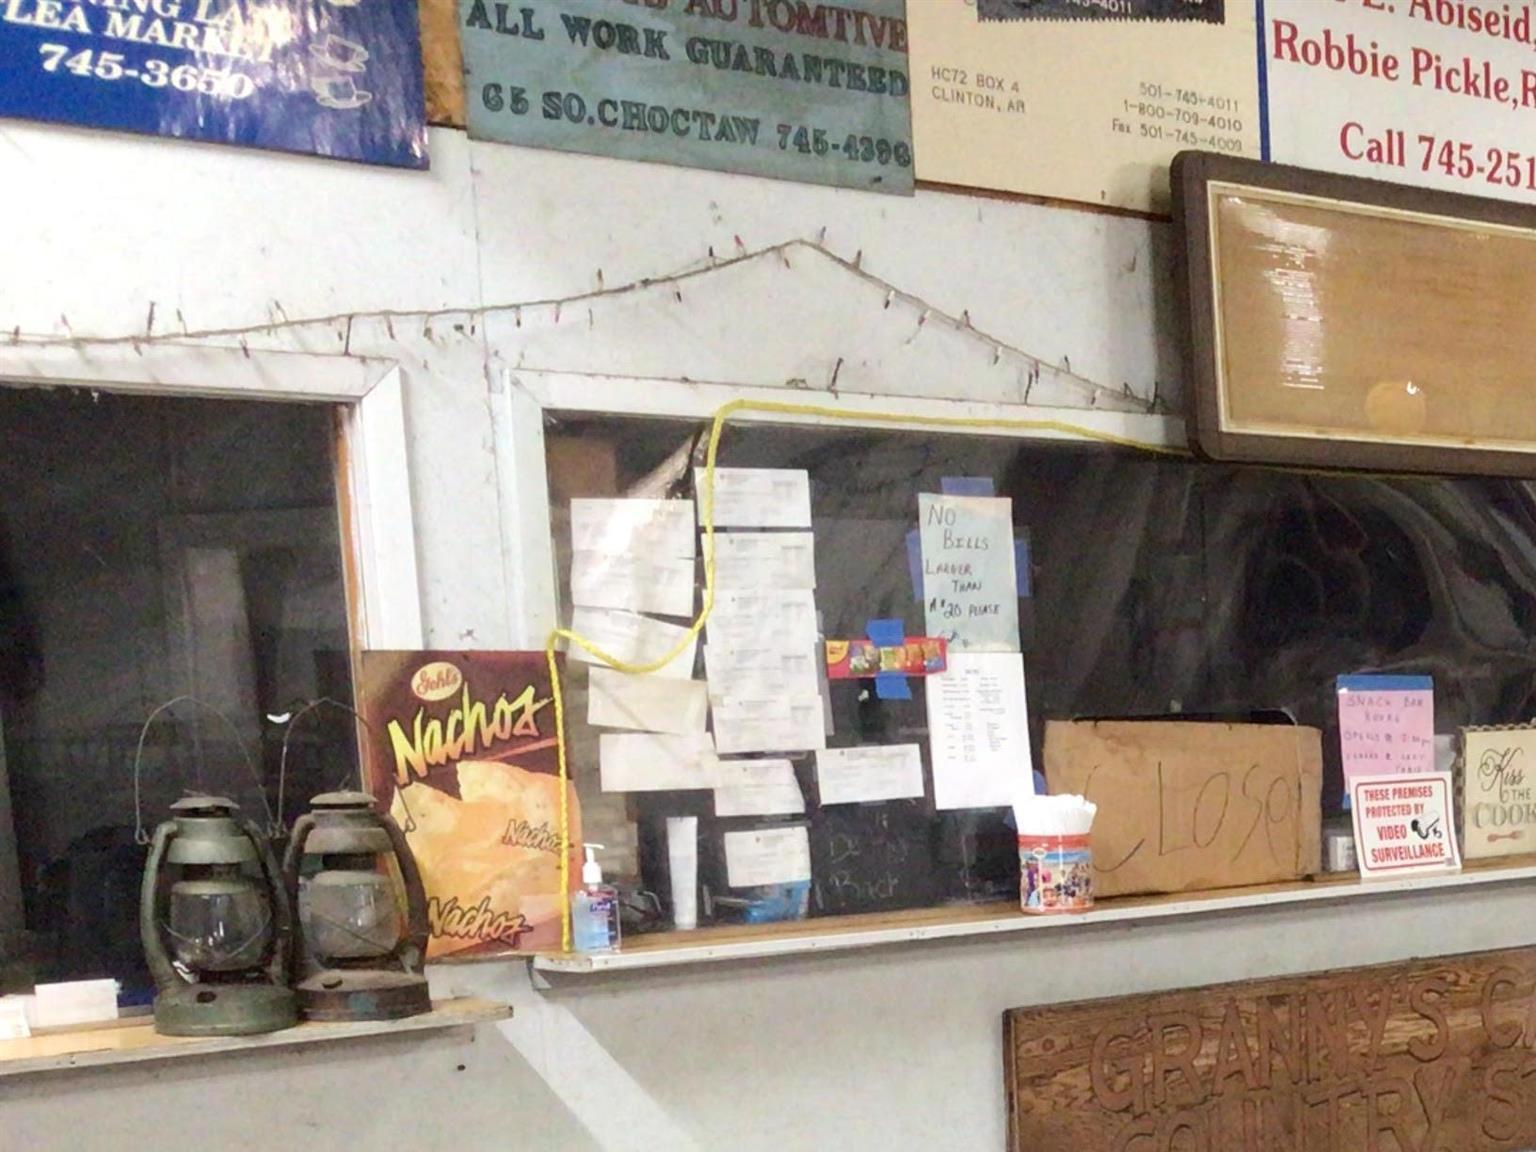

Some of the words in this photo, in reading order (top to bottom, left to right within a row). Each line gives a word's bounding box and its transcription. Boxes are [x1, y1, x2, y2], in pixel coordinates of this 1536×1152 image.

[465, 0, 545, 41] ALL
[560, 13, 671, 62] WORK
[686, 36, 909, 98] GUARANTEED
[1271, 18, 1400, 82] Robbie
[38, 43, 255, 100] 745-3650
[931, 66, 968, 86] HC72
[976, 74, 1005, 92] BOX
[1006, 100, 1026, 114] AR
[1139, 81, 1240, 113] 501-745-4011
[1123, 99, 1243, 132] 1-800-709-4010
[1140, 119, 1243, 152] 501-745-4009
[1339, 121, 1407, 168] Call
[928, 503, 957, 527] NO
[943, 528, 989, 551] BILLS
[387, 679, 556, 787] Nachoz
[1477, 747, 1526, 804] Kiss
[1364, 789, 1391, 803] THESE
[1392, 785, 1434, 801] PREMISES
[1511, 787, 1532, 801] THE
[1365, 804, 1412, 819] PROTECTED
[1414, 803, 1425, 815] BY
[1376, 824, 1408, 842] VIDEO
[1371, 842, 1446, 864] SURVEILLANCE
[1090, 974, 1451, 1113] GRANNY'S
